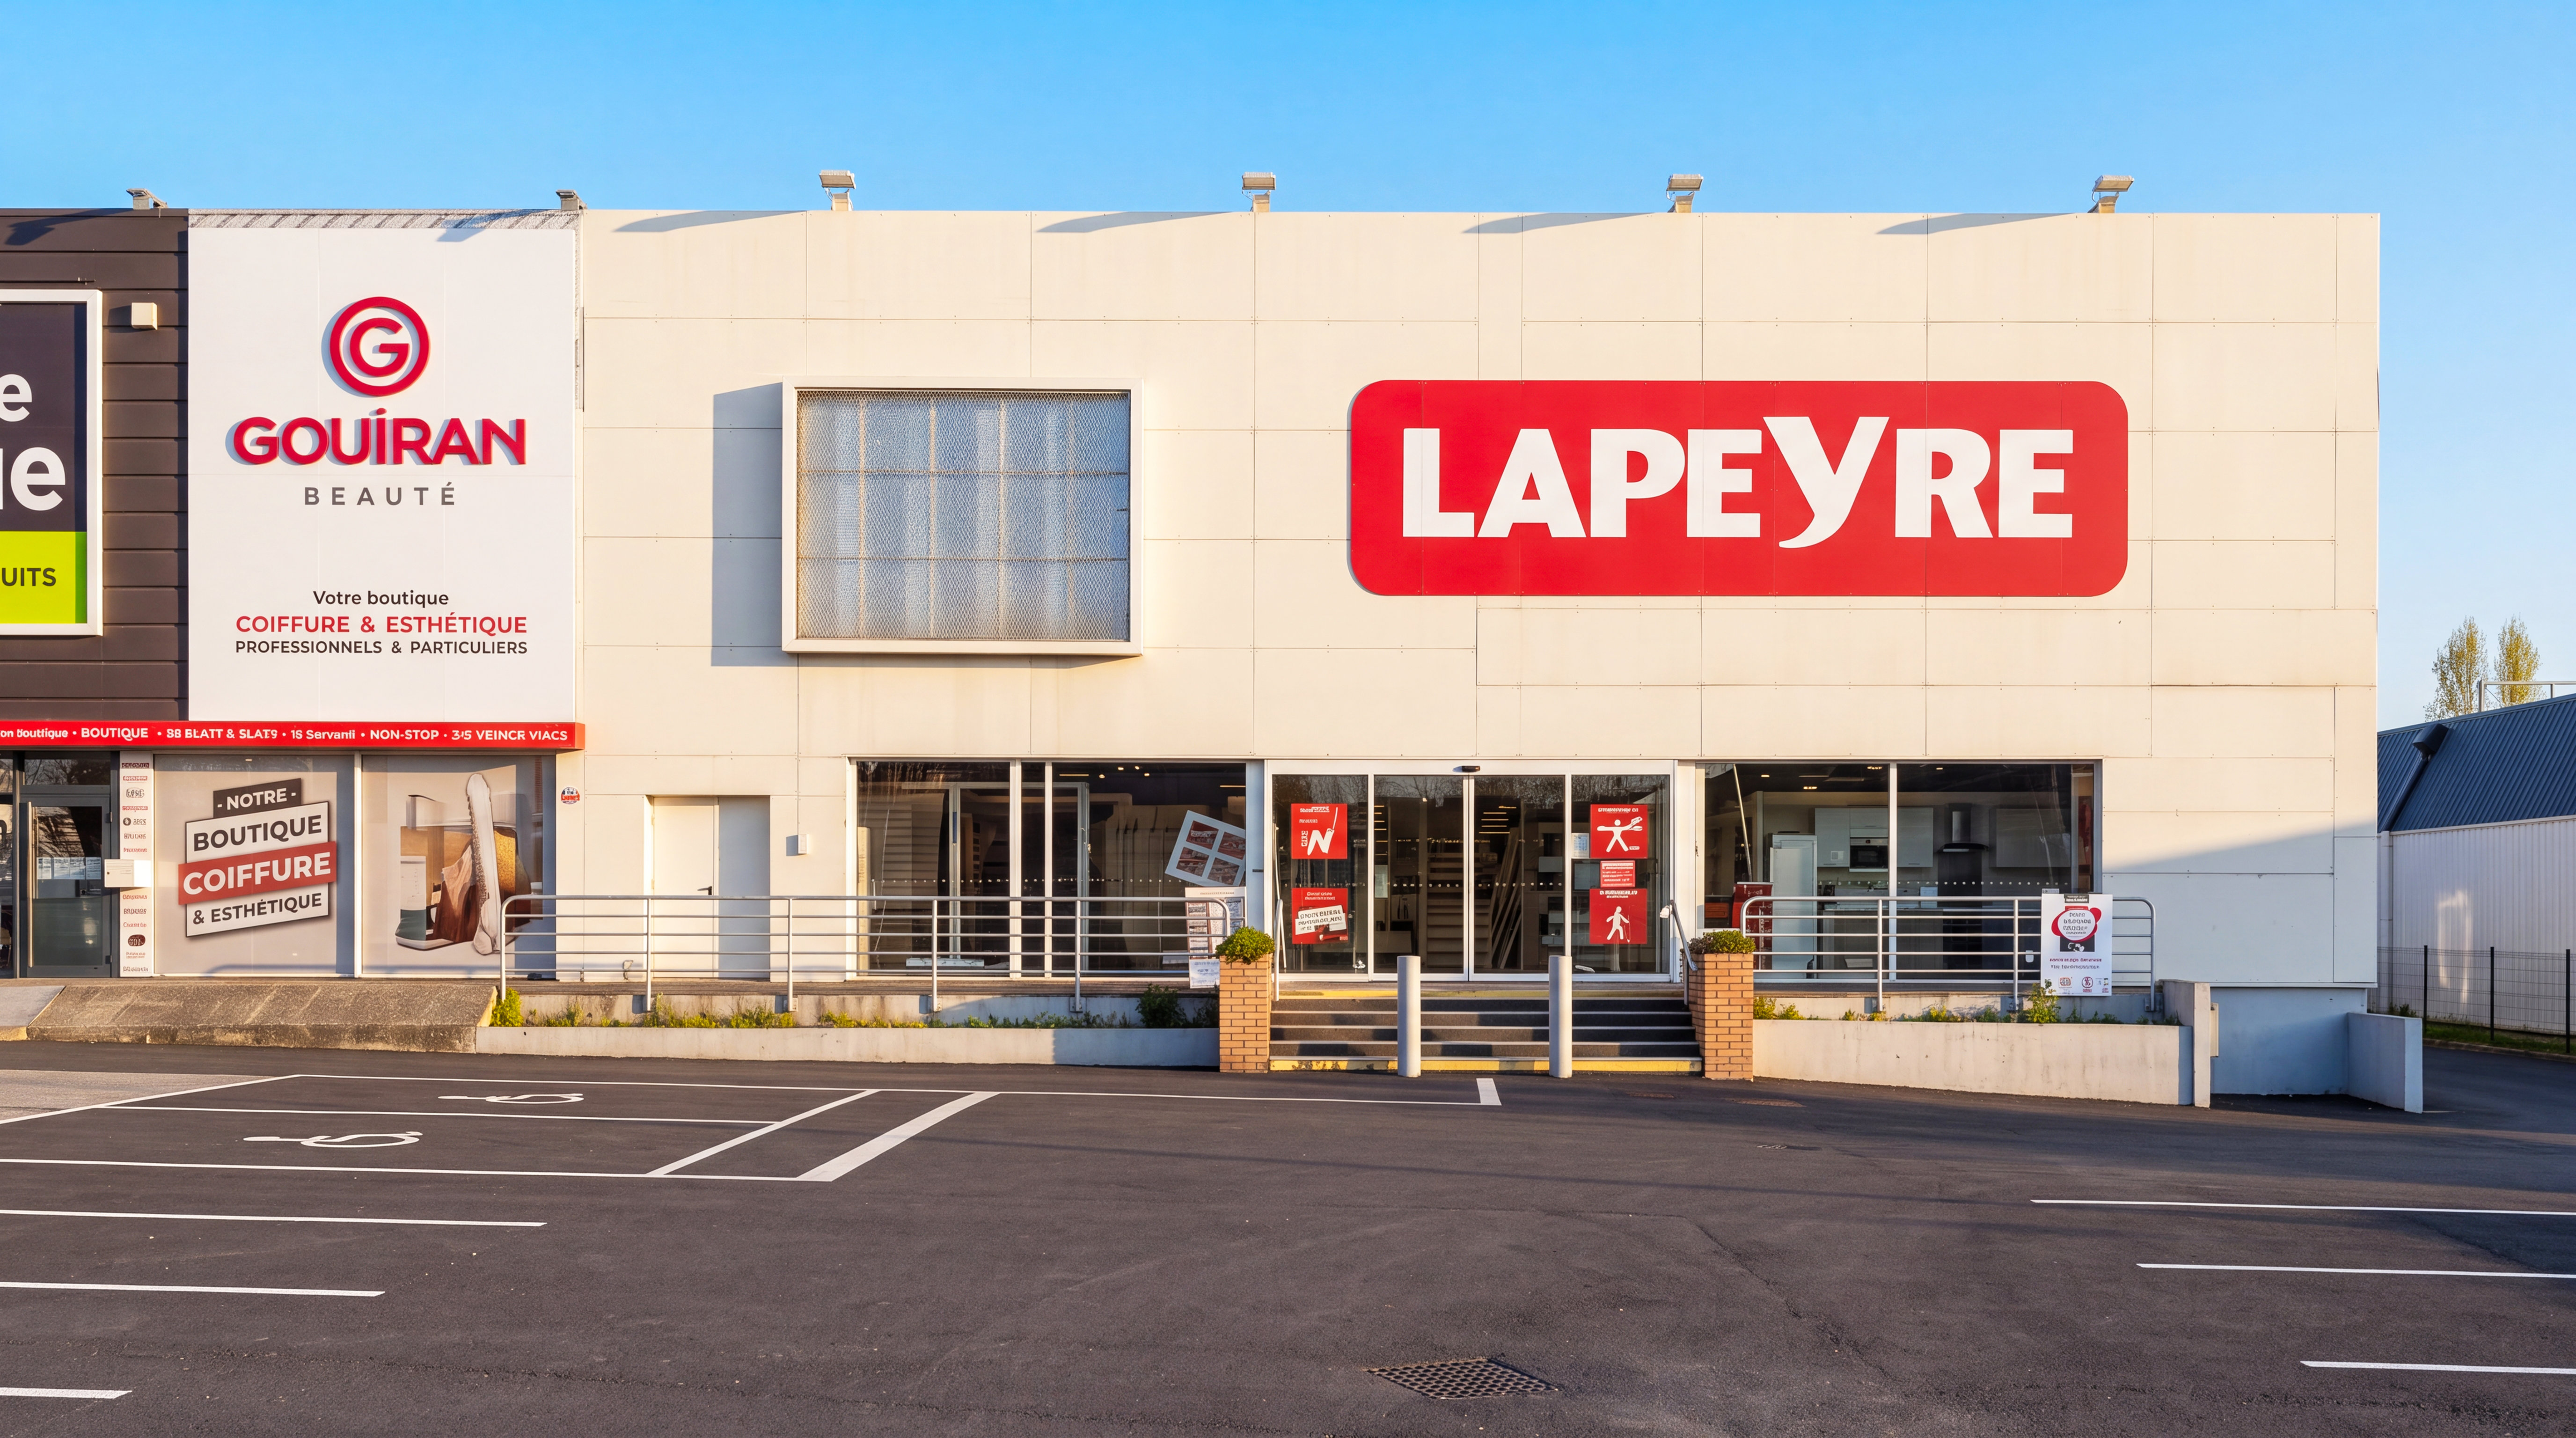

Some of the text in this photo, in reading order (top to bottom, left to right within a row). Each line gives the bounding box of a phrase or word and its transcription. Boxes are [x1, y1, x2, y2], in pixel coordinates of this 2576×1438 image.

[305, 482, 454, 506] BEAUTÉ
[1403, 416, 2073, 549] LAPEYRE
[313, 590, 449, 609] Votre boutique
[236, 612, 527, 637] COIFFURE & ESTHÉTIQUE
[236, 641, 527, 654] PROFESSIONNELS & PARTICULIERS
[81, 728, 148, 741] BOUTIQUE
[226, 728, 235, 739] &
[370, 729, 439, 740] NON-STOP
[227, 788, 287, 810] NOTRE
[193, 814, 322, 851] BOUTIQUE
[183, 851, 331, 895] COIFFURE
[192, 893, 322, 925] & ESTHÉTIQUE
